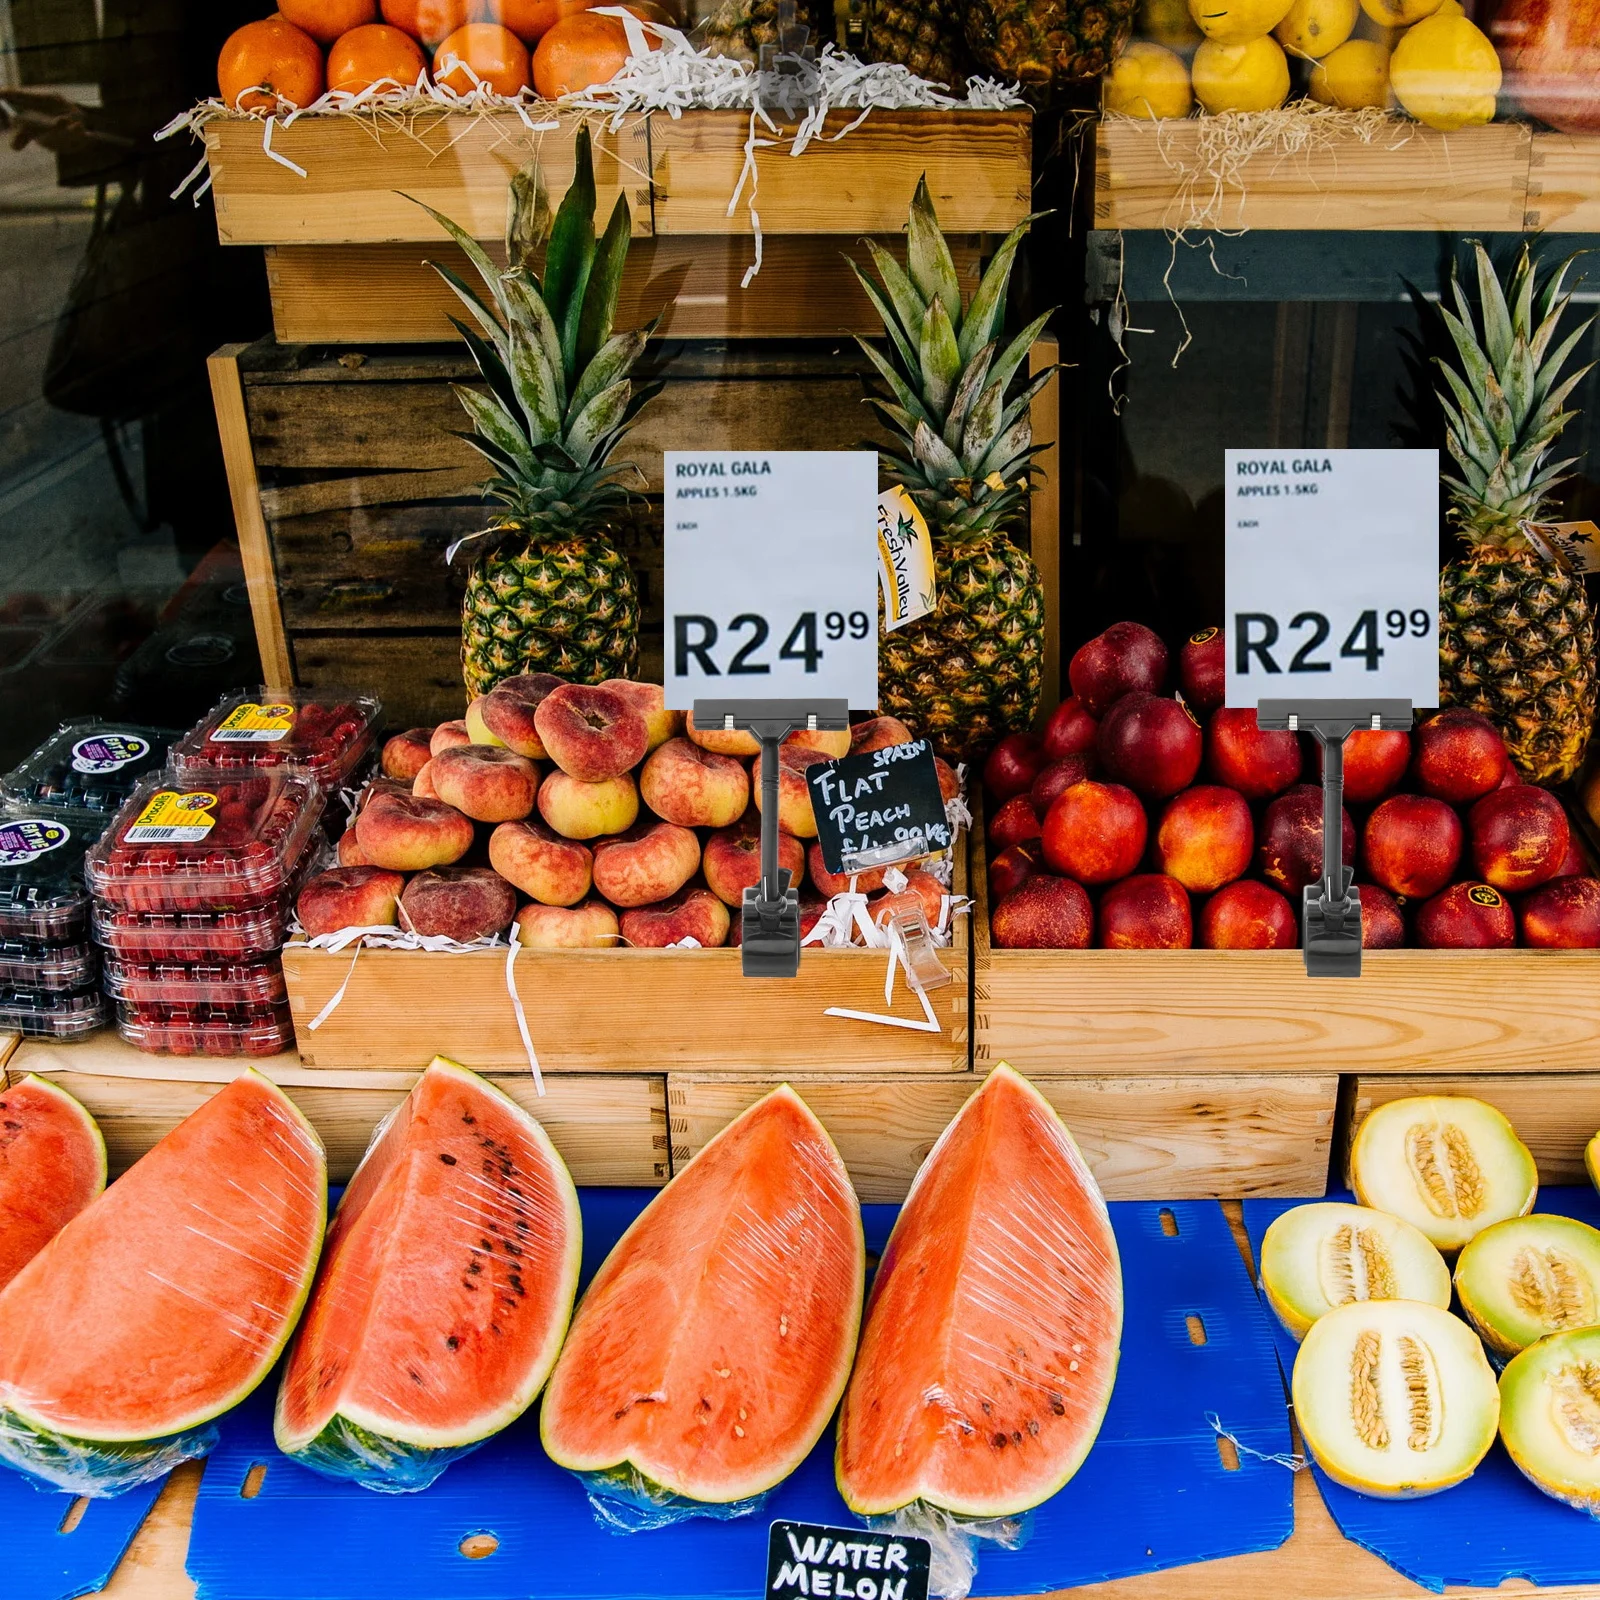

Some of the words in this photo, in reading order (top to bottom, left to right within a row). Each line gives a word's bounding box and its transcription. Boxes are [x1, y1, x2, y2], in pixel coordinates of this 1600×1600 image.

[676, 462, 727, 477] ROYAL
[731, 460, 772, 476] GALA
[1237, 460, 1288, 475] ROYAL
[1292, 458, 1333, 474] GALA
[676, 487, 720, 499] APPLES
[723, 485, 757, 498] 1.5KG
[1237, 485, 1281, 497] APPLES
[1284, 483, 1319, 496] 1.5KG
[873, 740, 926, 768] SPAIN
[813, 769, 890, 806] FLAT
[829, 803, 911, 834] PEACH
[787, 1530, 909, 1572] WATER
[772, 1561, 907, 1600] MELON
